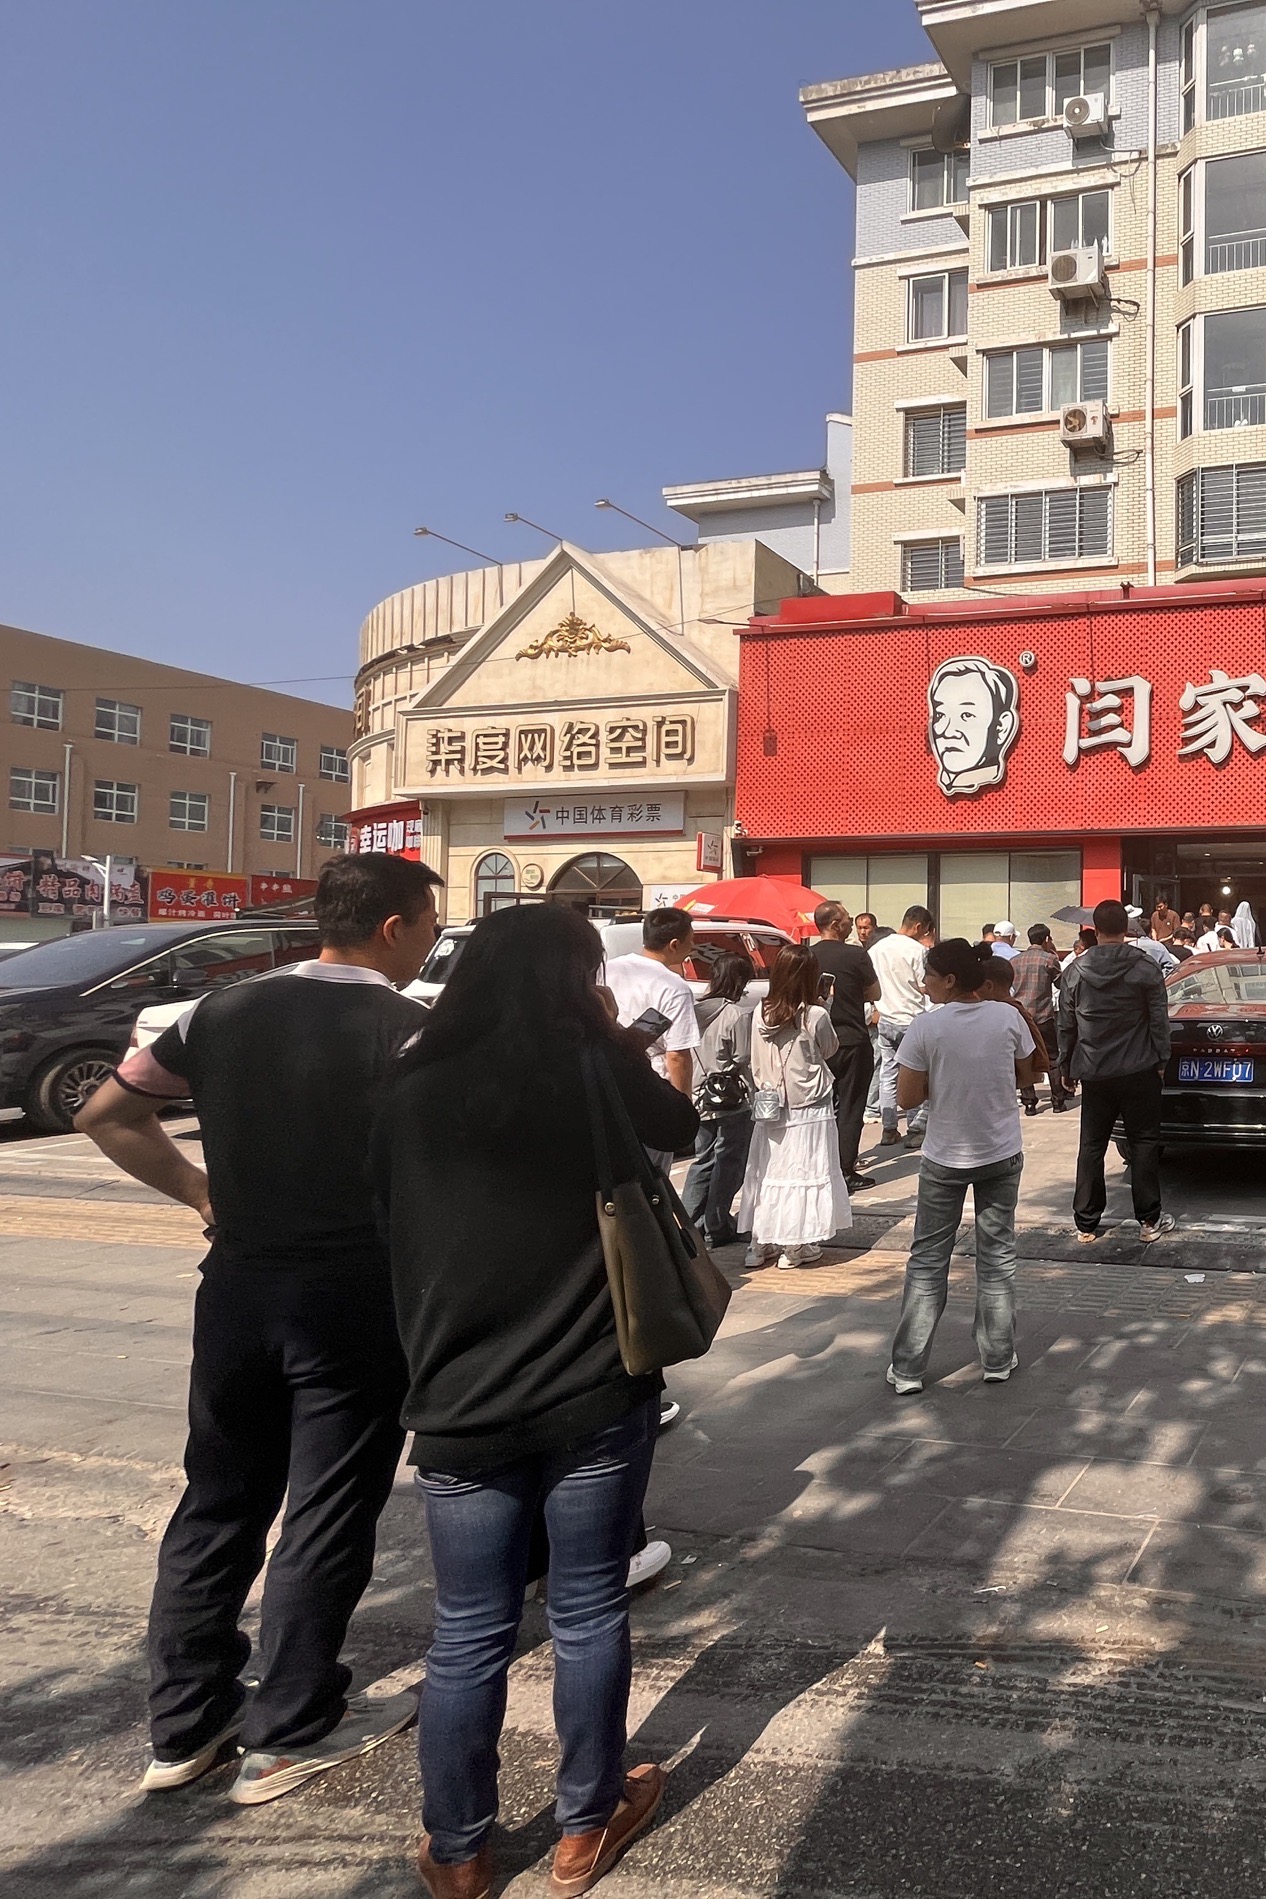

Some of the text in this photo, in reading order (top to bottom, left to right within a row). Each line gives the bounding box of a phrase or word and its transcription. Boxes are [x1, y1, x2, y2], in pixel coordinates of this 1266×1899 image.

[426, 714, 695, 777] 柒度网络空间
[555, 803, 661, 826] 中国体育彩票
